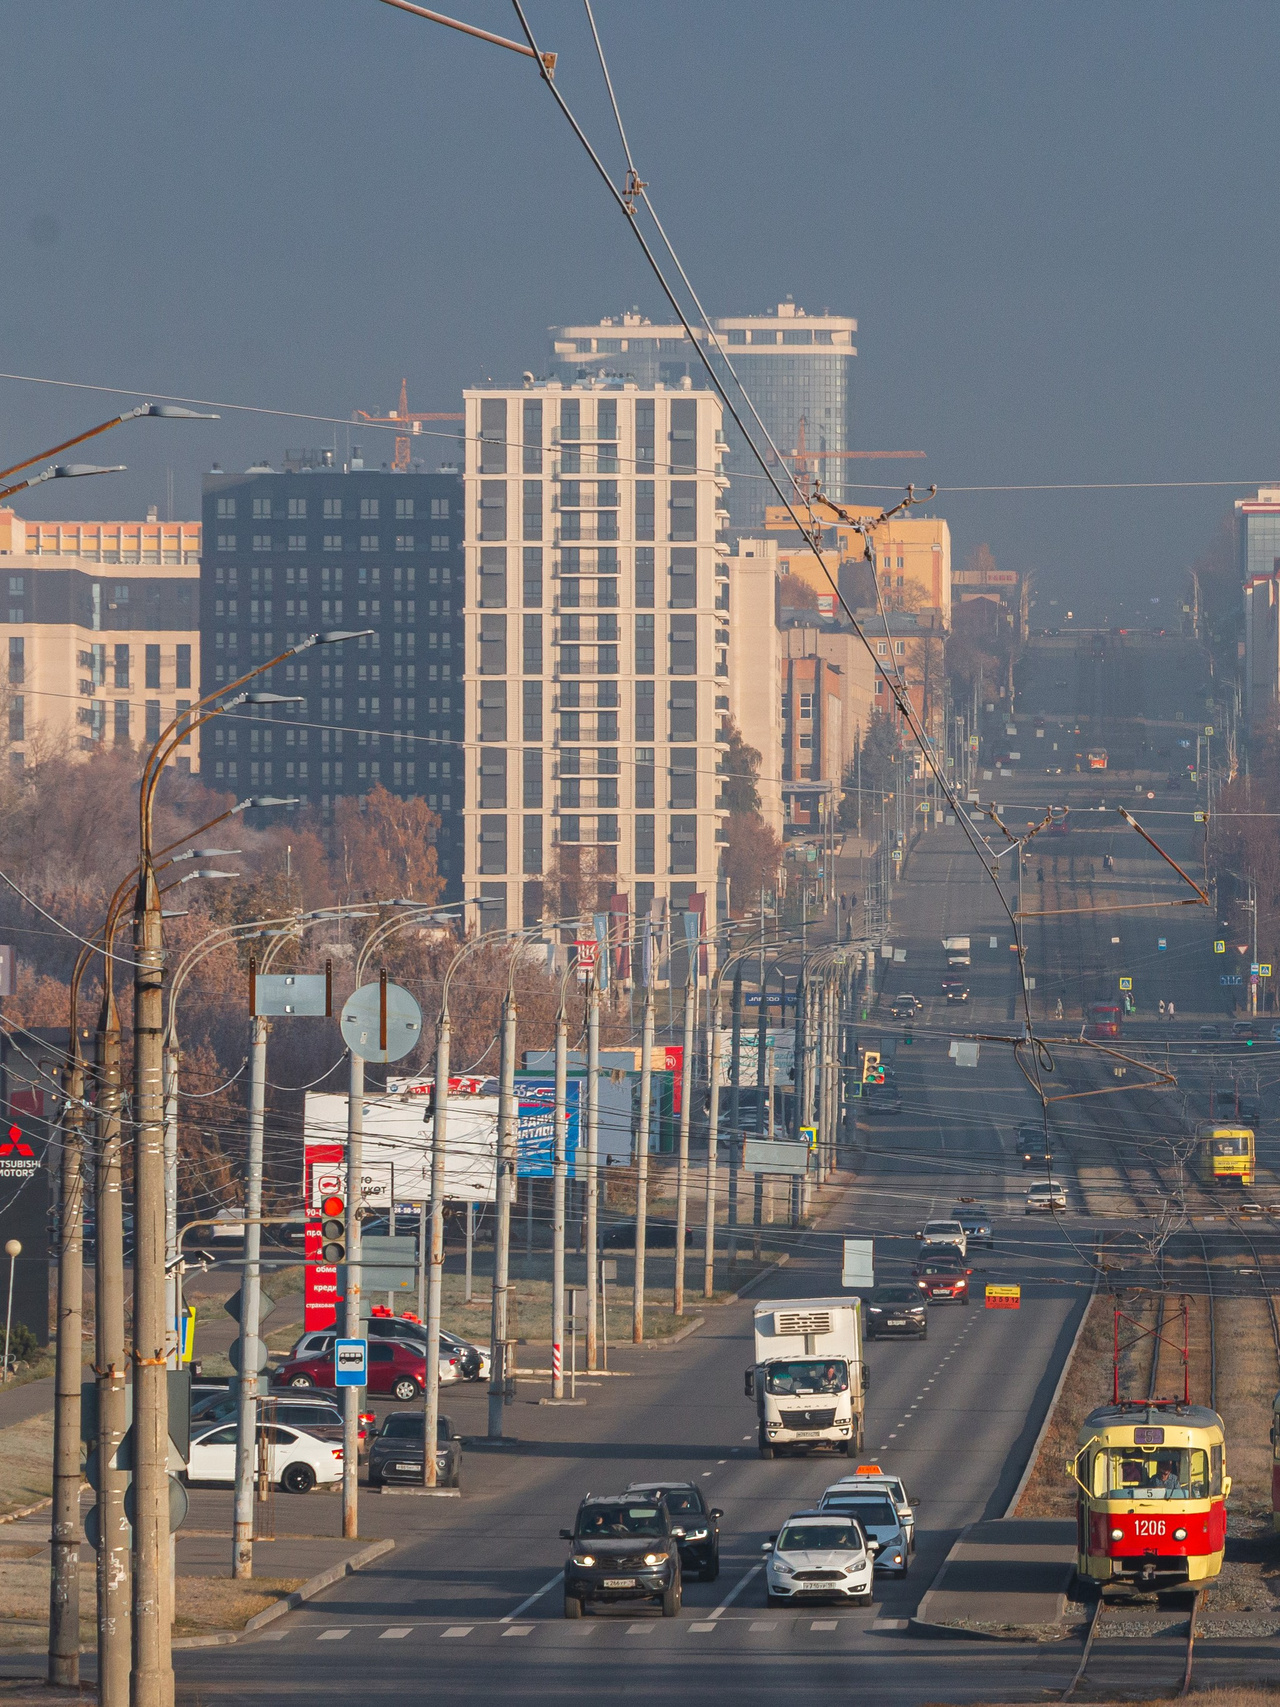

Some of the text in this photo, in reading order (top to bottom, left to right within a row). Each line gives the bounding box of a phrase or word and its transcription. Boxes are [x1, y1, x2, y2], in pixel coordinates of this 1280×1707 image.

[1144, 1430, 1154, 1444] 5
[1146, 1489, 1154, 1498] 5
[1134, 1519, 1166, 1536] 1206
